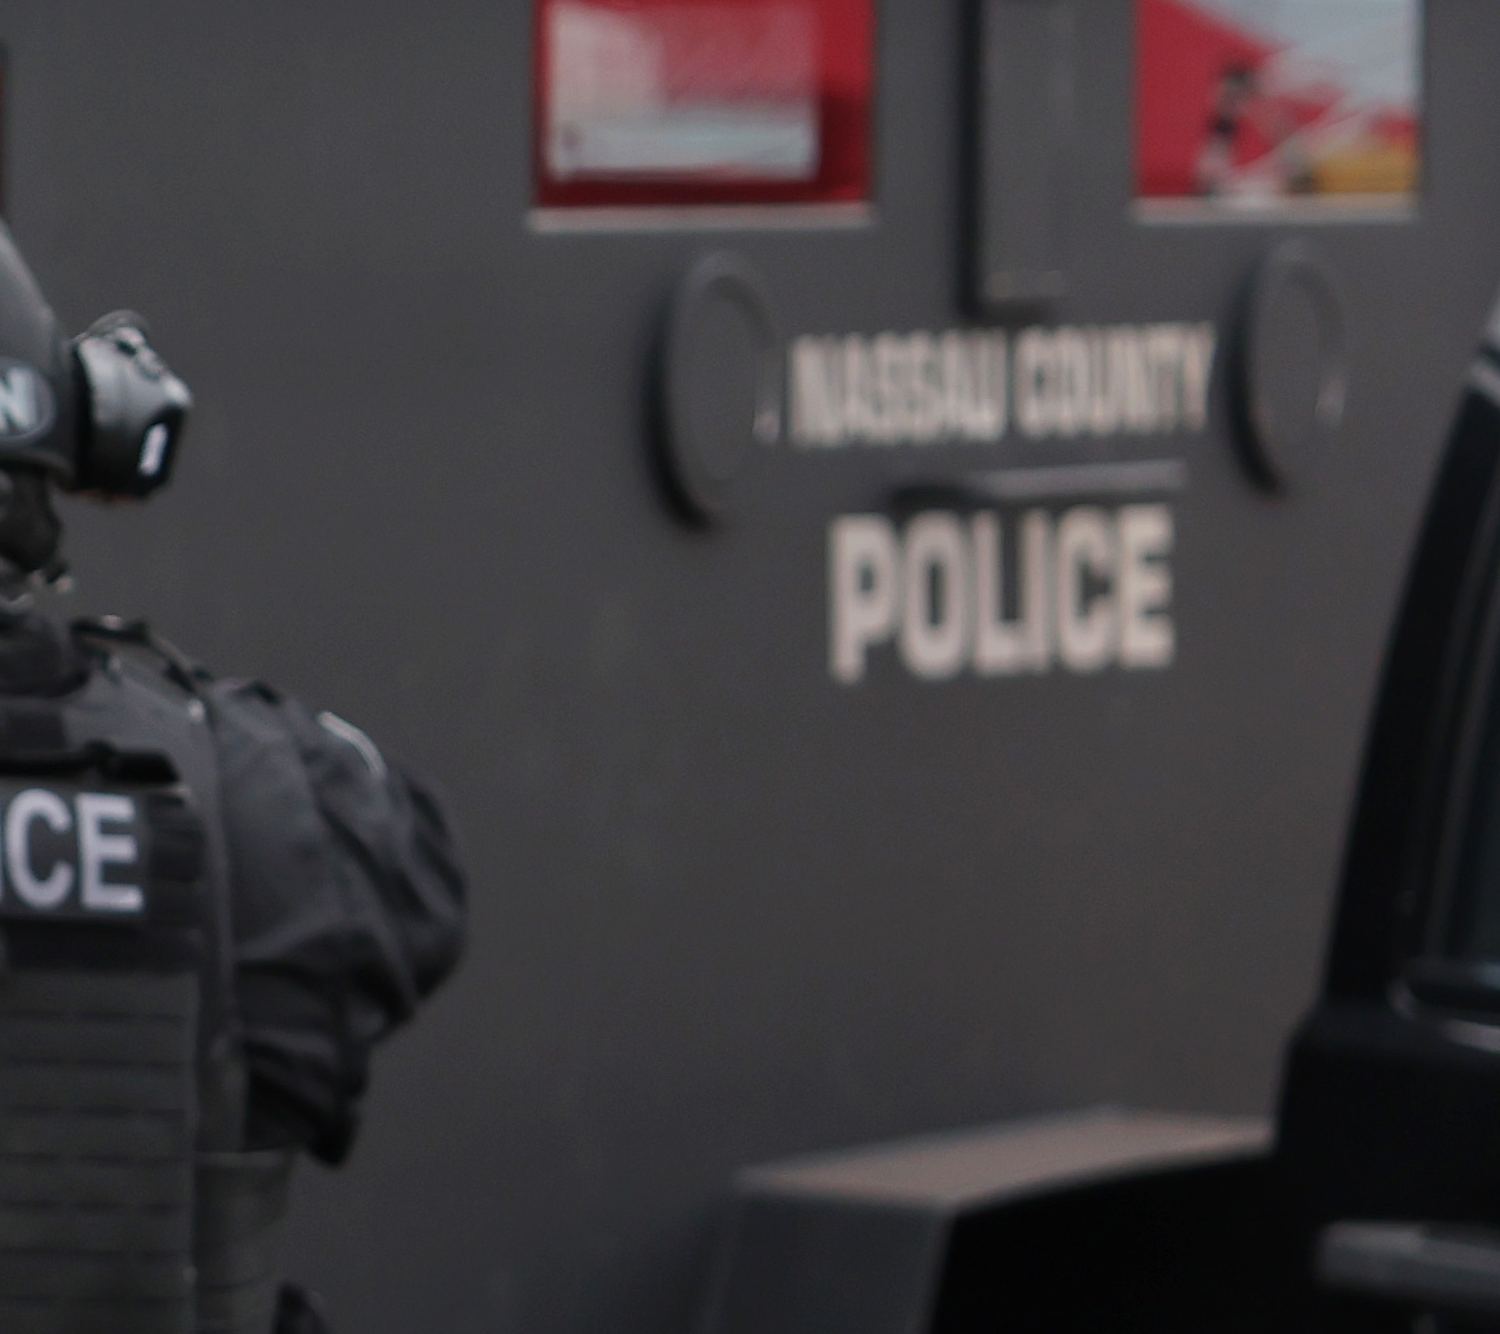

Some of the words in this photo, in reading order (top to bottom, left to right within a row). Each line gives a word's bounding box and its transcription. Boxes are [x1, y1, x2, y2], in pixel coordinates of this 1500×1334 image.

[789, 329, 1008, 446] NASSAU
[1013, 321, 1216, 437] COUNTY
[828, 503, 1176, 685] POLICE
